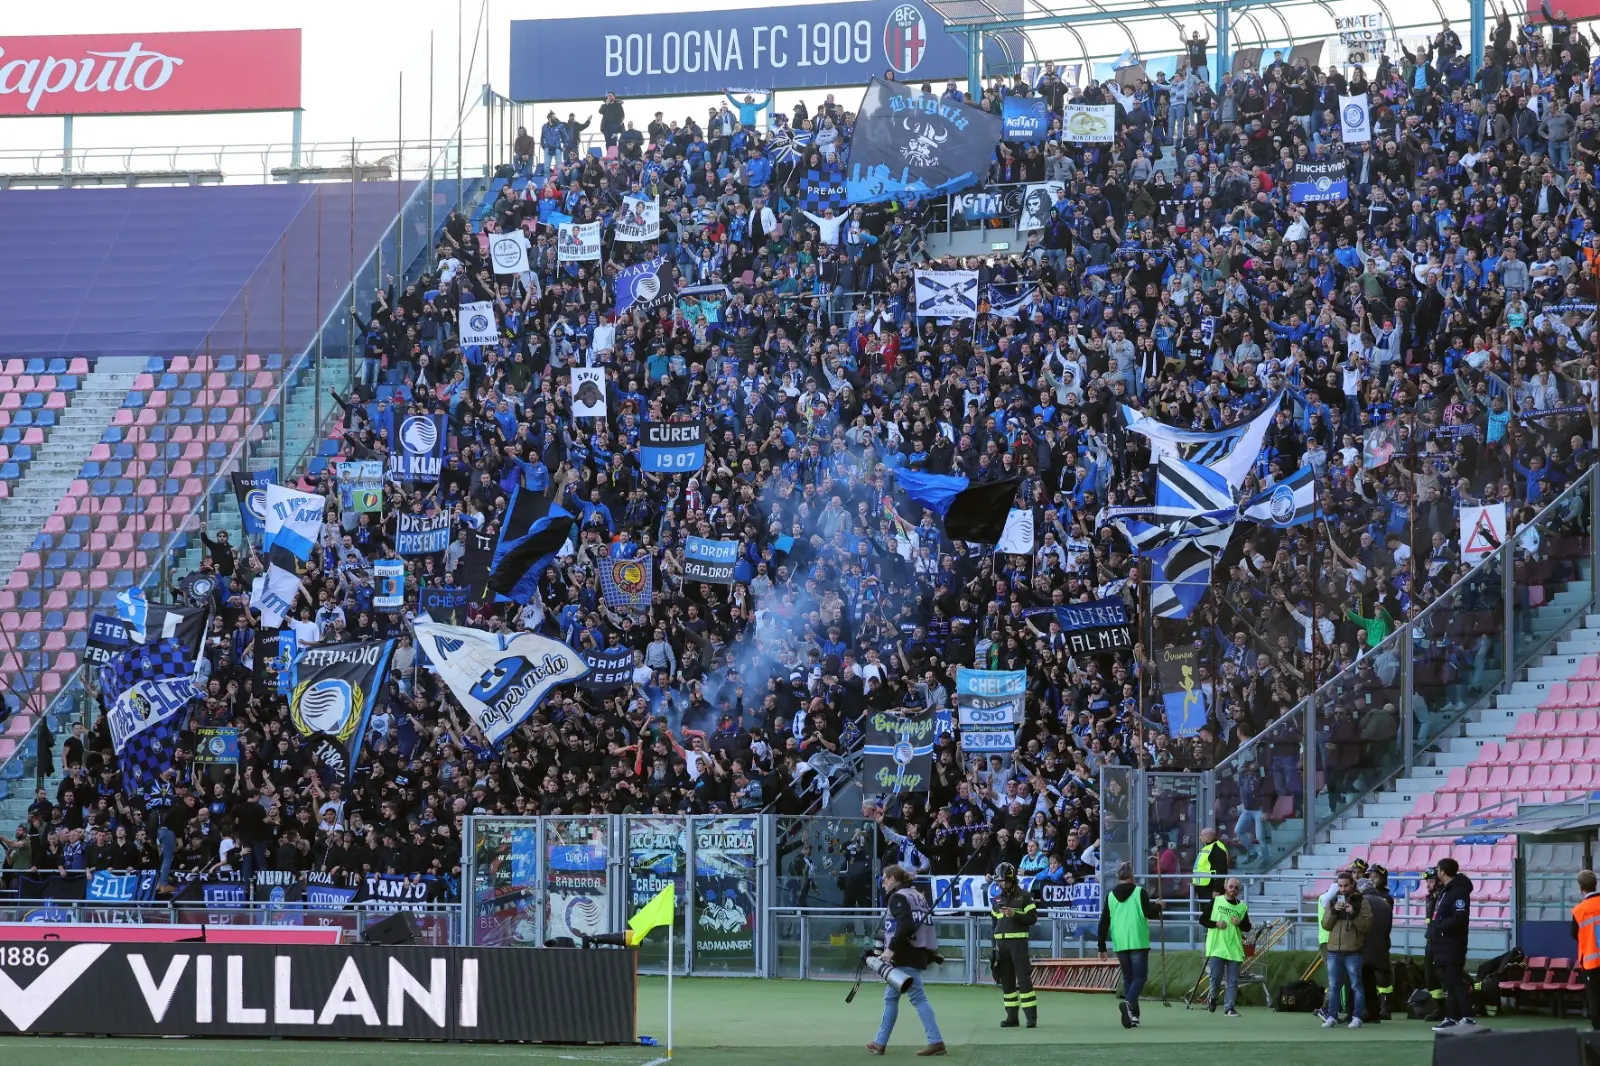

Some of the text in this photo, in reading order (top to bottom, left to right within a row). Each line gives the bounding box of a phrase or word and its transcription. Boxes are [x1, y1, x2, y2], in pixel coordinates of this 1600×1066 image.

[895, 10, 916, 21] BFC
[1335, 15, 1377, 29] BONATE
[605, 20, 872, 77] BOLOGNA FC 1909
[0, 42, 184, 111] aputo
[888, 91, 970, 131] Brigata
[1005, 115, 1039, 129] AGITATI
[951, 192, 1003, 217] AGITATI
[398, 531, 449, 553] PRESENTE
[587, 653, 632, 670] GAMBA
[870, 713, 933, 740] Brianza
[875, 765, 923, 794] Group
[698, 833, 754, 850] GUARDIA
[0, 946, 50, 967] 1886
[126, 953, 480, 1028] VILLANI
